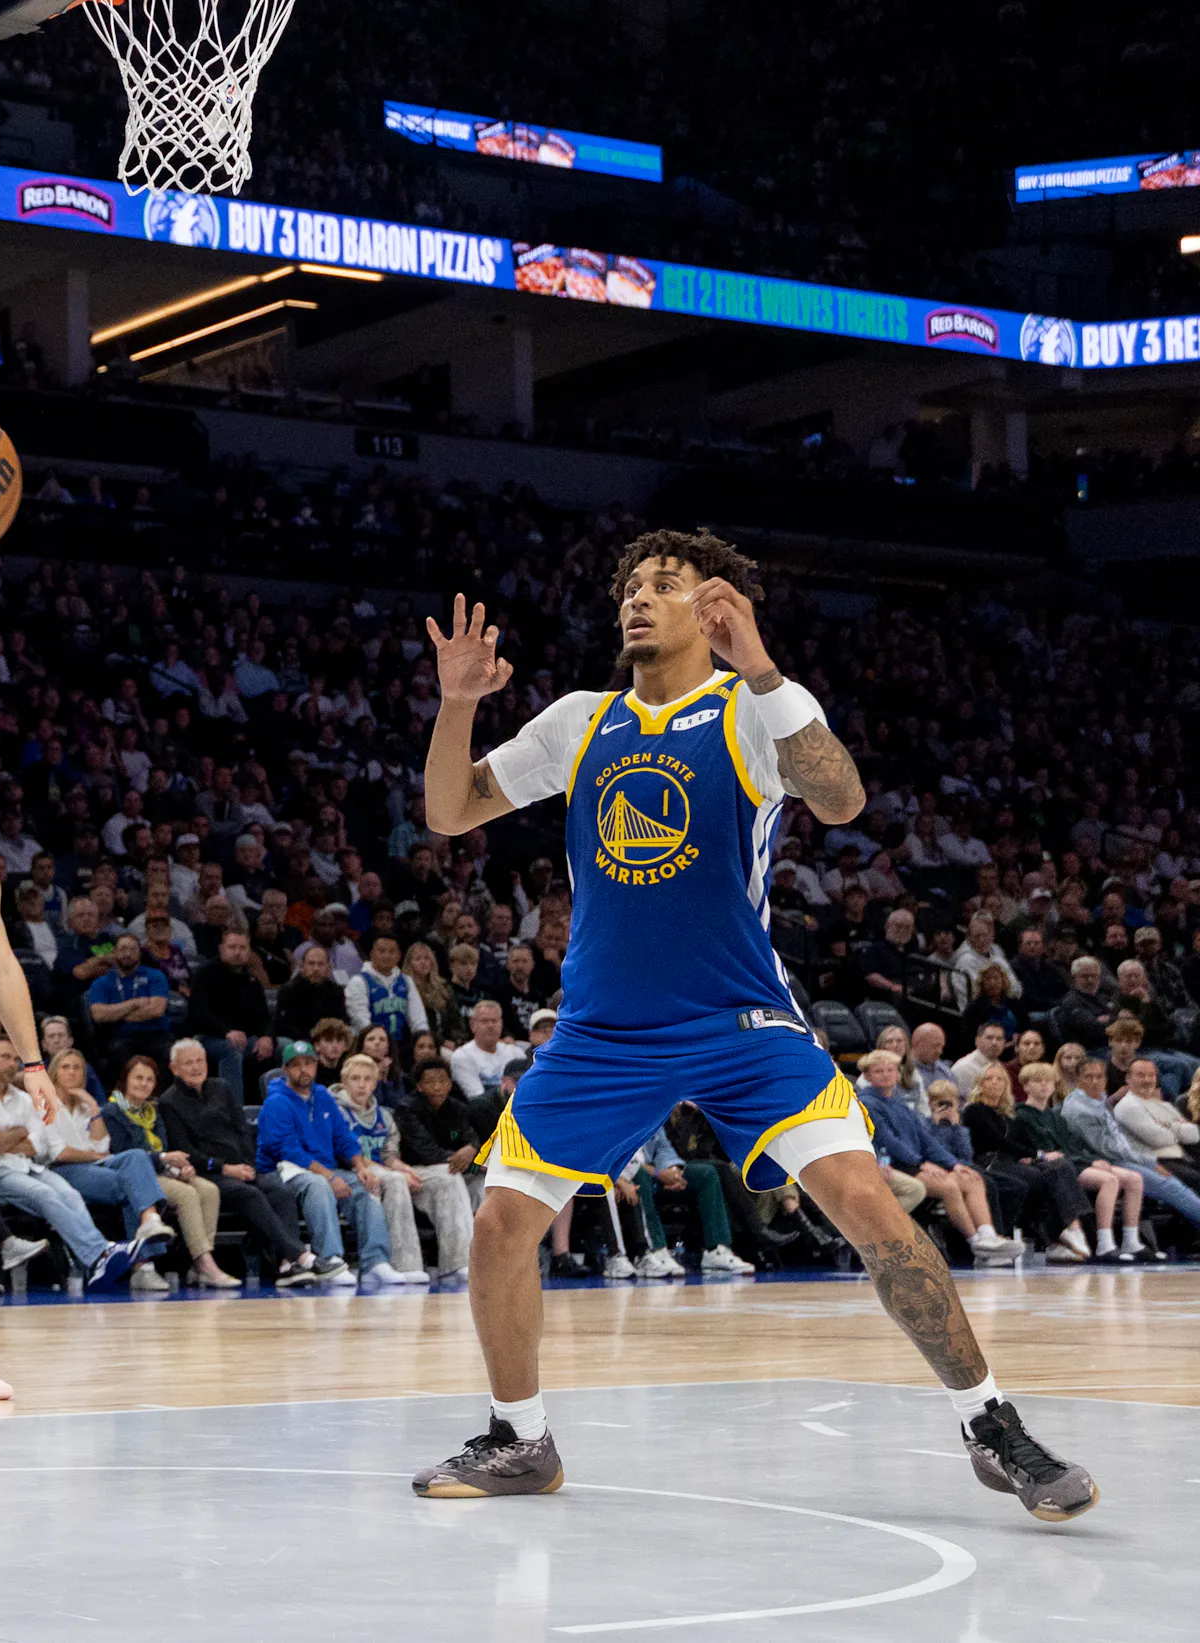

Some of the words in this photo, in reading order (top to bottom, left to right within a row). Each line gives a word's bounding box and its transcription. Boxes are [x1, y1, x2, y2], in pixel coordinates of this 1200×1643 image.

[23, 186, 54, 209] RED
[55, 184, 109, 220] BARON
[228, 202, 276, 254] BUY
[279, 210, 296, 257] 3
[297, 212, 340, 262] RED
[342, 218, 417, 271] BARON
[663, 265, 696, 311] GET
[699, 272, 713, 314] 2
[930, 315, 953, 335] RED
[954, 312, 994, 344] BARON
[1082, 322, 1140, 367] BUY
[1142, 320, 1161, 363] 3
[1164, 315, 1200, 361] RE
[595, 752, 652, 788] GOLDEN
[656, 753, 696, 784] STATE
[662, 788, 670, 817] 1
[594, 843, 700, 886] WARRIORS
